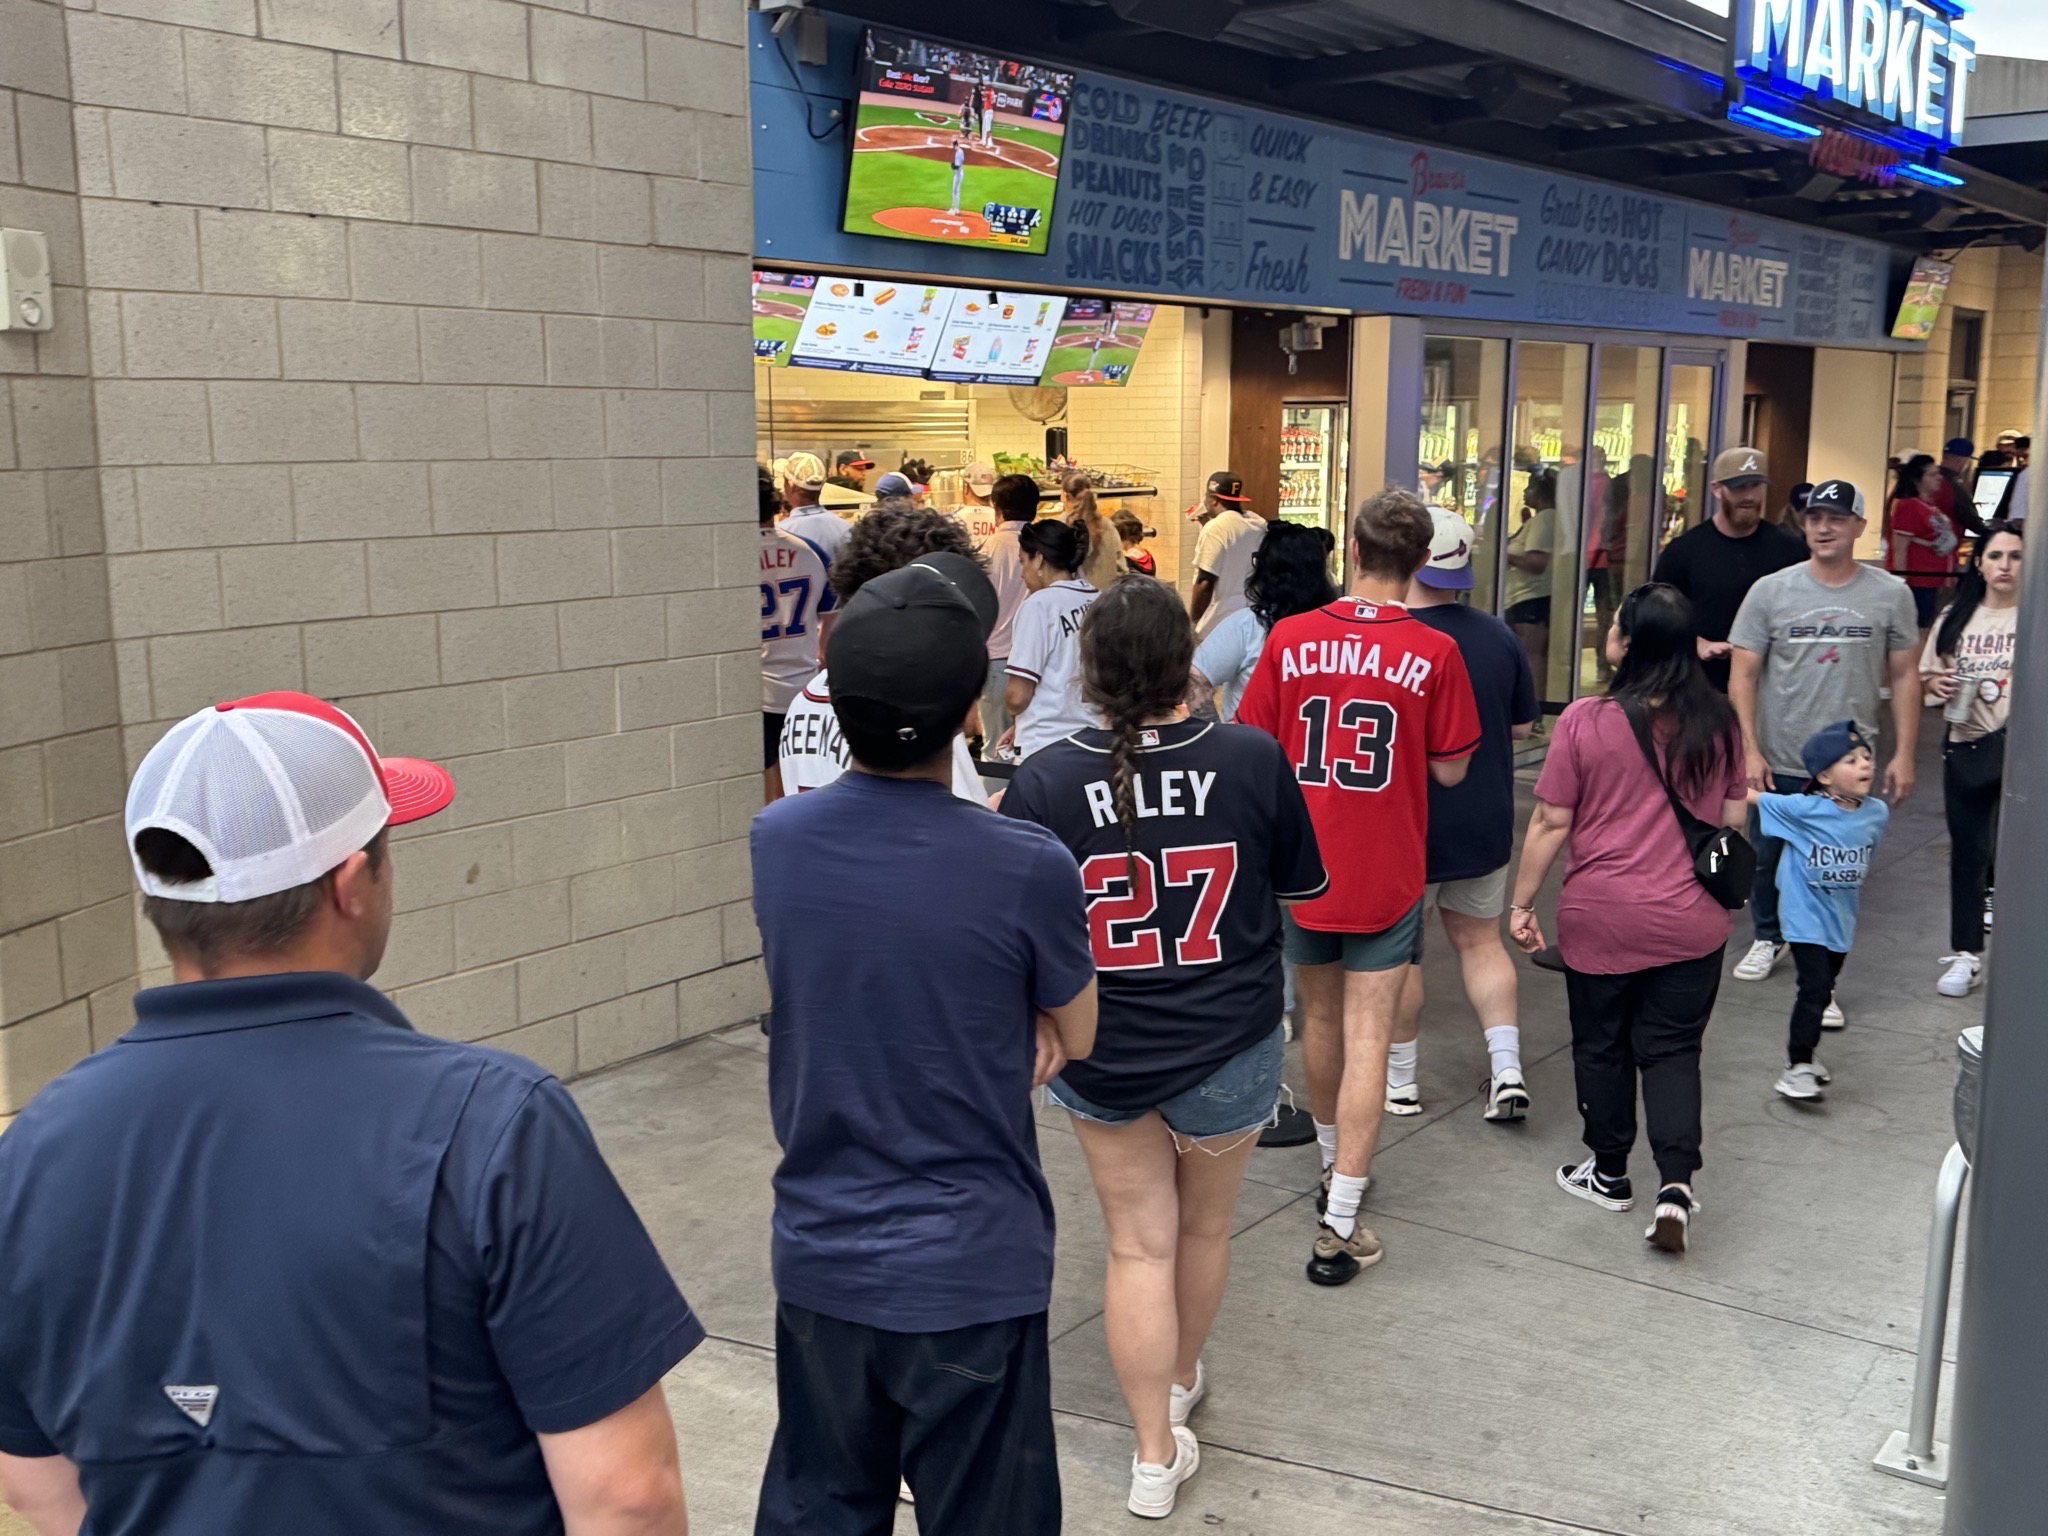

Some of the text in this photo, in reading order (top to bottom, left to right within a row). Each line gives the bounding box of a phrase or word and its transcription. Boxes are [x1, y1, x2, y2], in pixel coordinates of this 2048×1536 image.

[1751, 0, 1977, 146] MARKET
[1073, 83, 1211, 142] COLD BEER
[1071, 118, 1162, 165] DRINKS
[1252, 123, 1315, 164] QUICK
[1071, 158, 1163, 203] PEANUTS
[1250, 171, 1319, 209] & EASY
[1541, 183, 1583, 229] Grab
[1067, 200, 1163, 235] HOT DOGS
[1166, 186, 1186, 291] EASY
[1187, 147, 1206, 287] QUICK
[1338, 188, 1519, 277] MARKET
[1621, 196, 1664, 243] HOT
[1065, 231, 1162, 287] SNACKS
[1245, 240, 1311, 295] Fresh
[1536, 235, 1602, 277] CANDY
[1602, 240, 1660, 290] DOGS
[1687, 247, 1789, 309] MARKET
[761, 575, 812, 643] 27
[1789, 626, 1873, 638] BRAVES
[1282, 633, 1432, 697] ACUÑA JR.
[1296, 695, 1398, 793] 13
[1084, 770, 1217, 828] RLEY
[1079, 841, 1238, 971] 27
